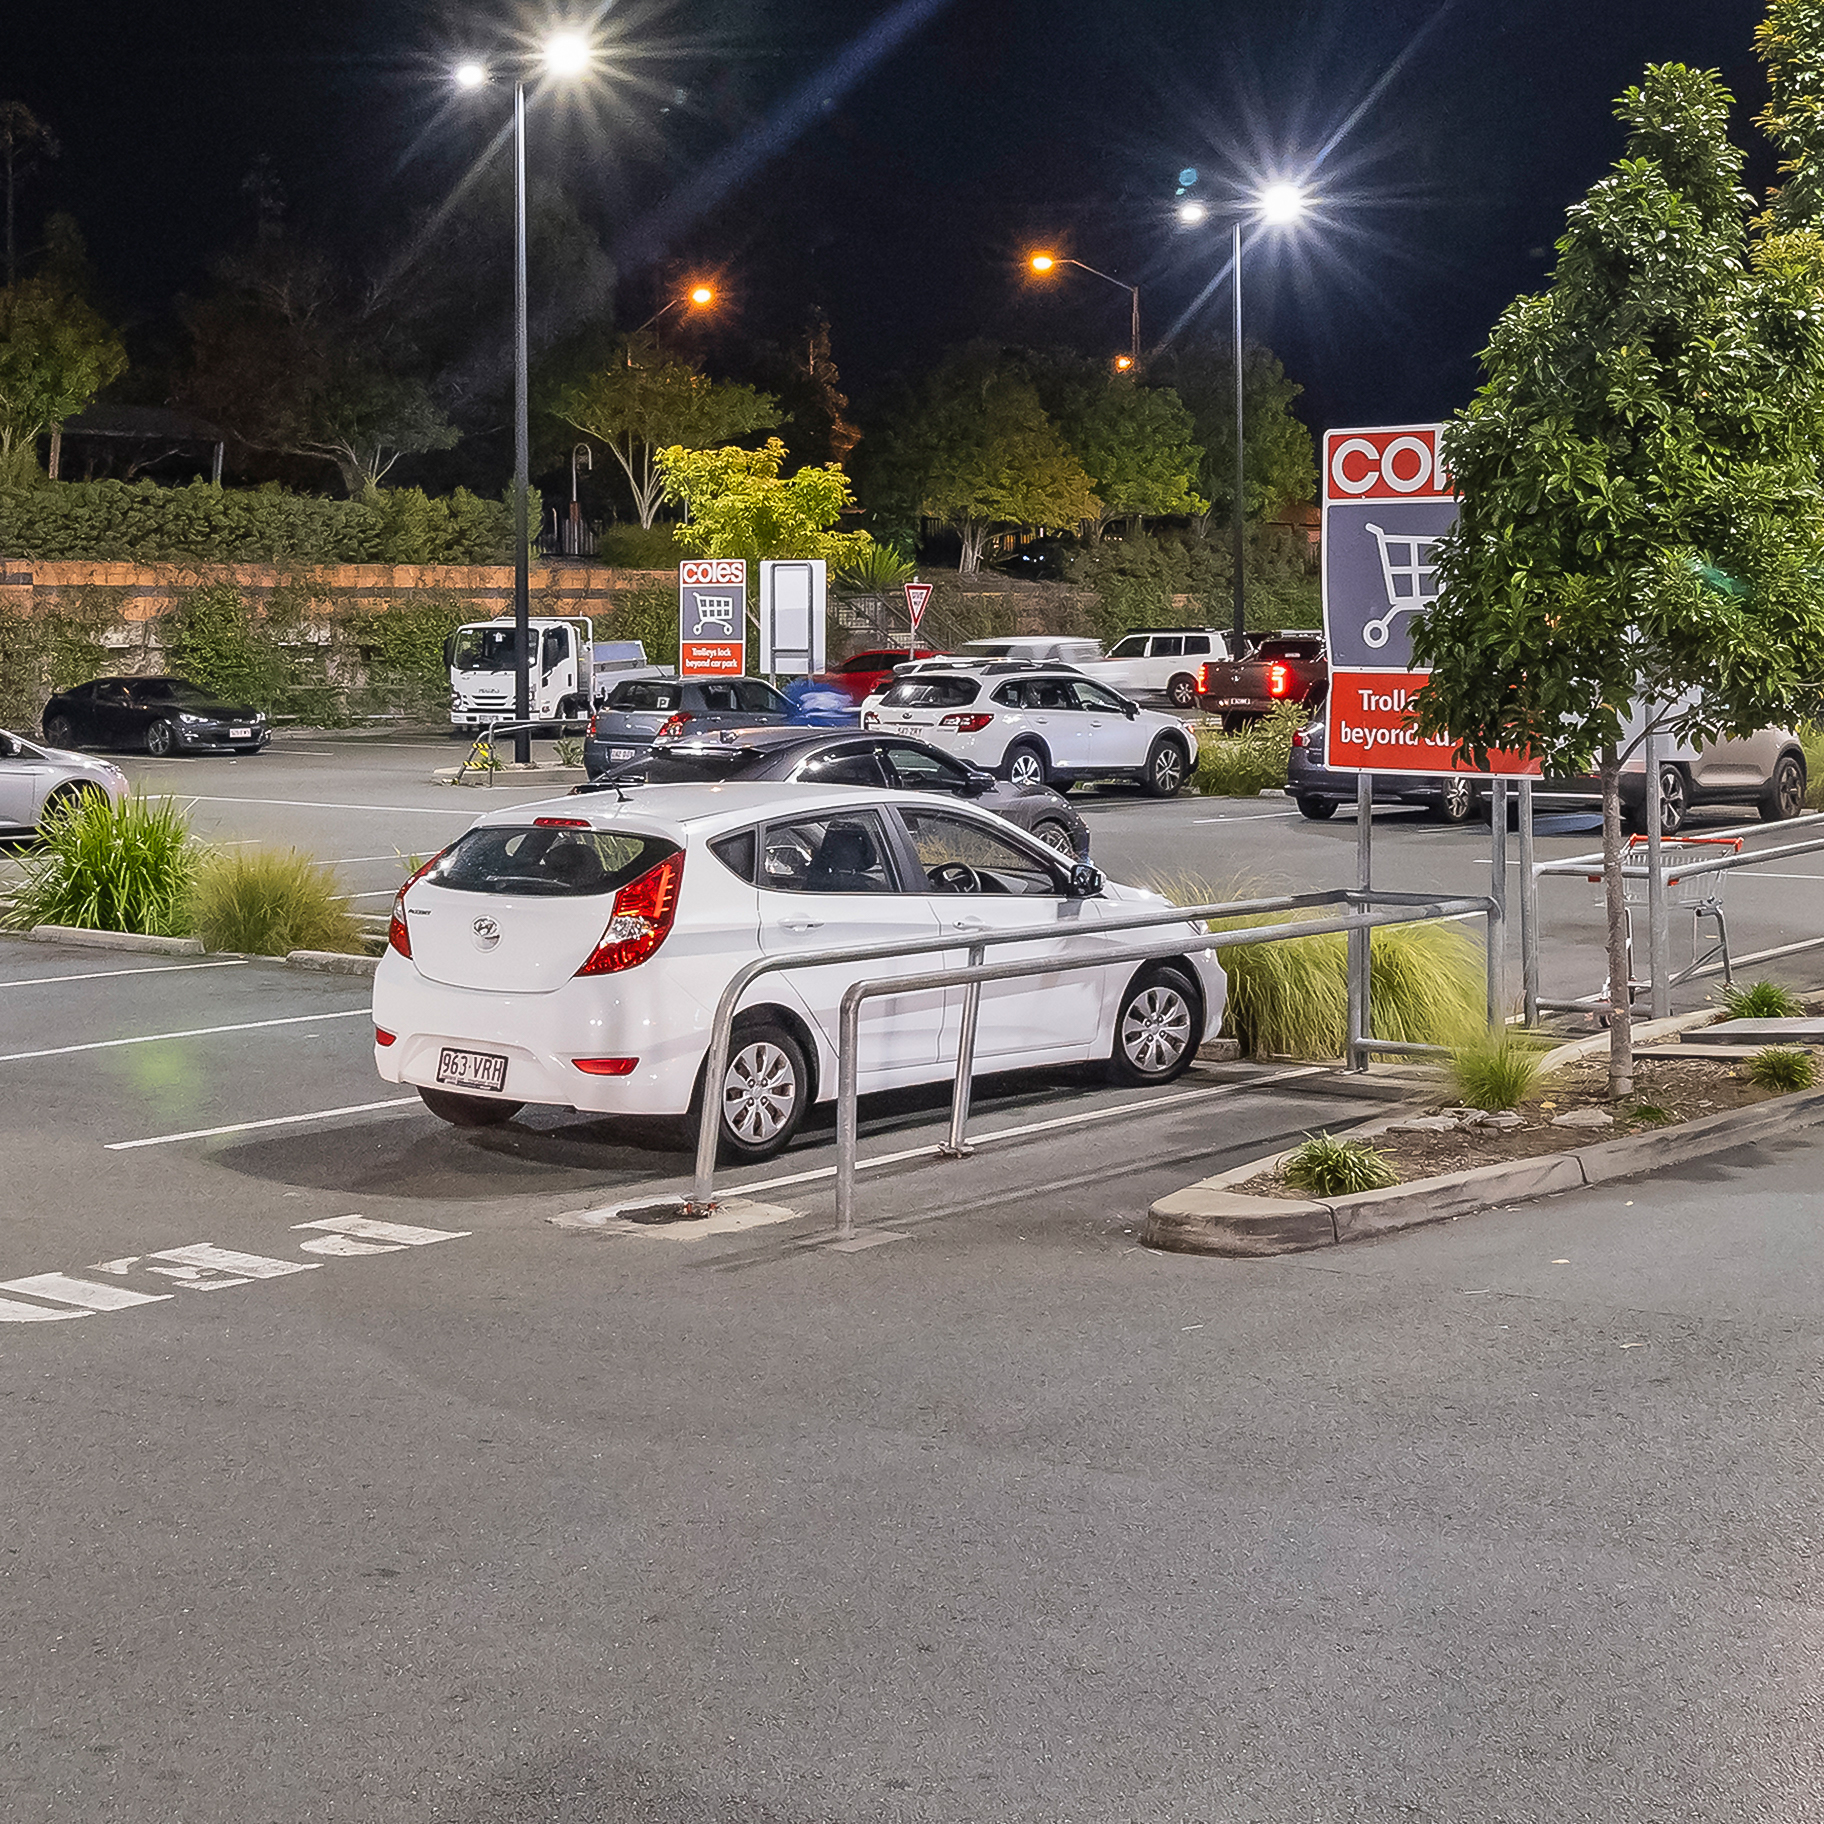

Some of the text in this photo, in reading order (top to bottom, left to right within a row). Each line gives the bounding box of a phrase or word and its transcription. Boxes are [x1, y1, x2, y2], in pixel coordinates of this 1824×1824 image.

[683, 562, 743, 583] coles
[717, 648, 731, 657] lock
[685, 659, 710, 669] beyond
[721, 659, 738, 669] park
